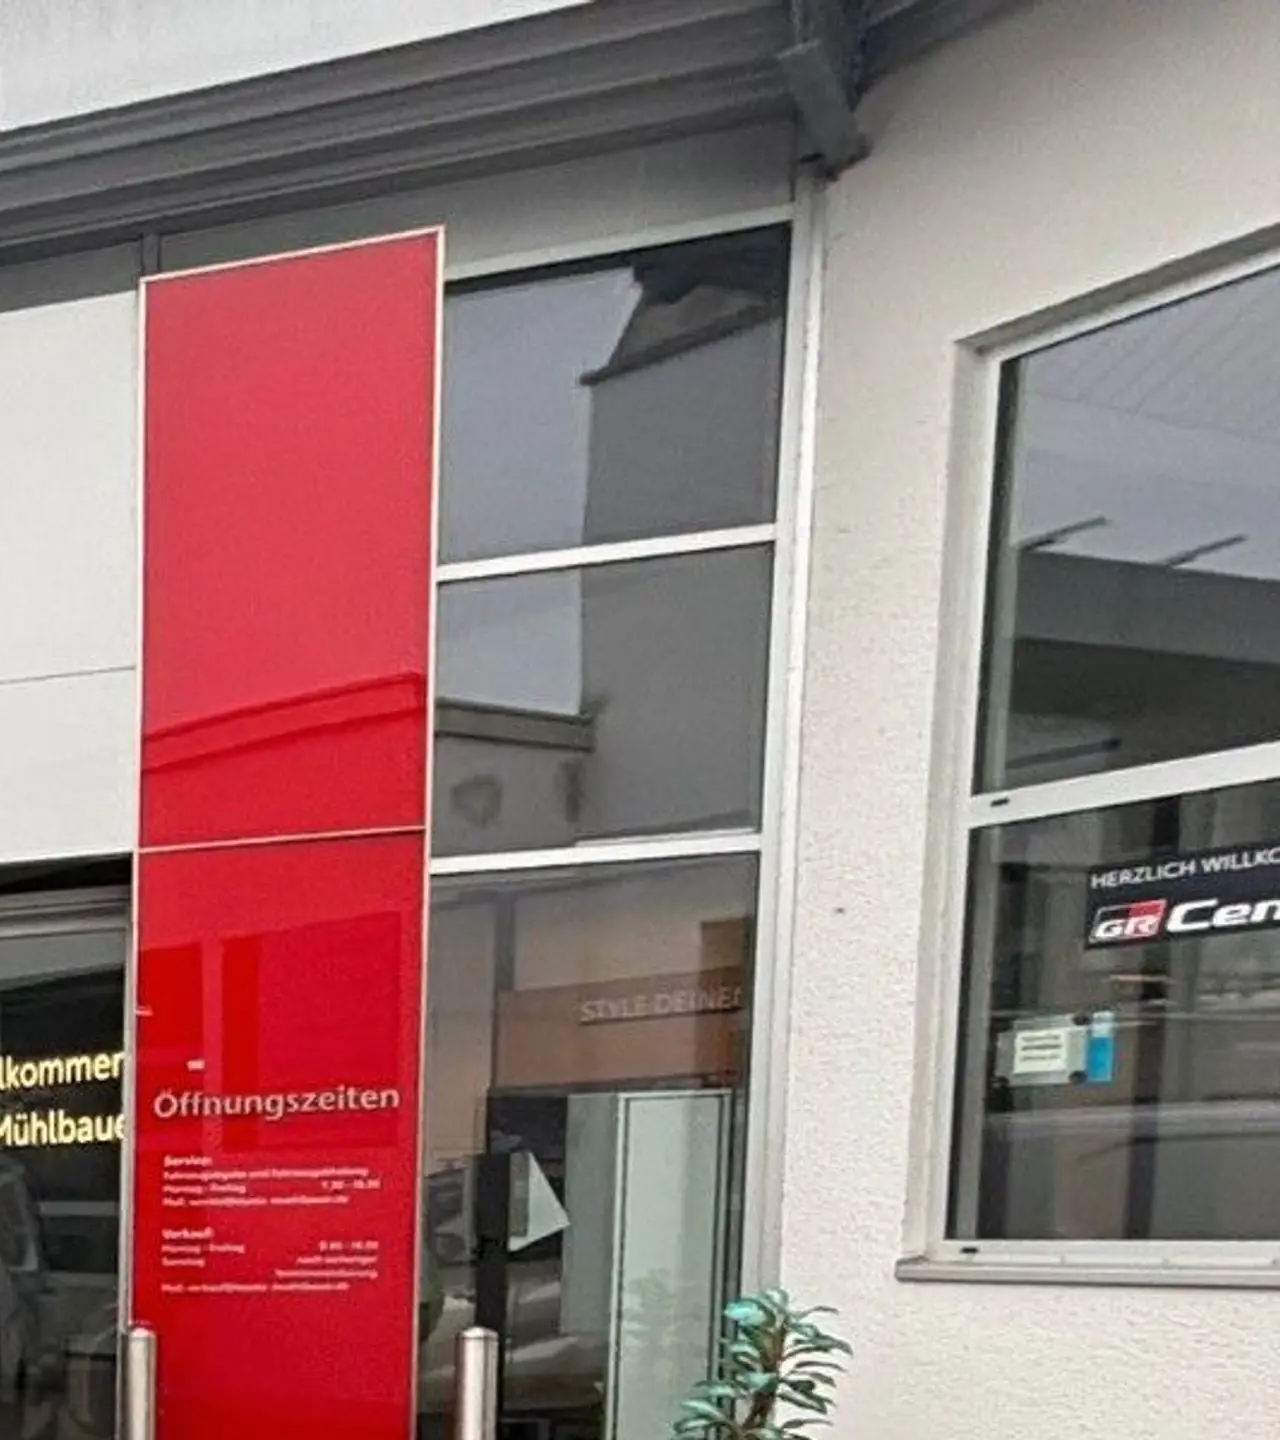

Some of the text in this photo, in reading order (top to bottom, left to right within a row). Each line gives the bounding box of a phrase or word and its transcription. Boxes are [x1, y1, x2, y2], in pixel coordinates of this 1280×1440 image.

[1091, 858, 1196, 889] HERZLICH
[1094, 898, 1280, 939] GR Cen
[153, 1084, 400, 1121] Öffnungszeiten
